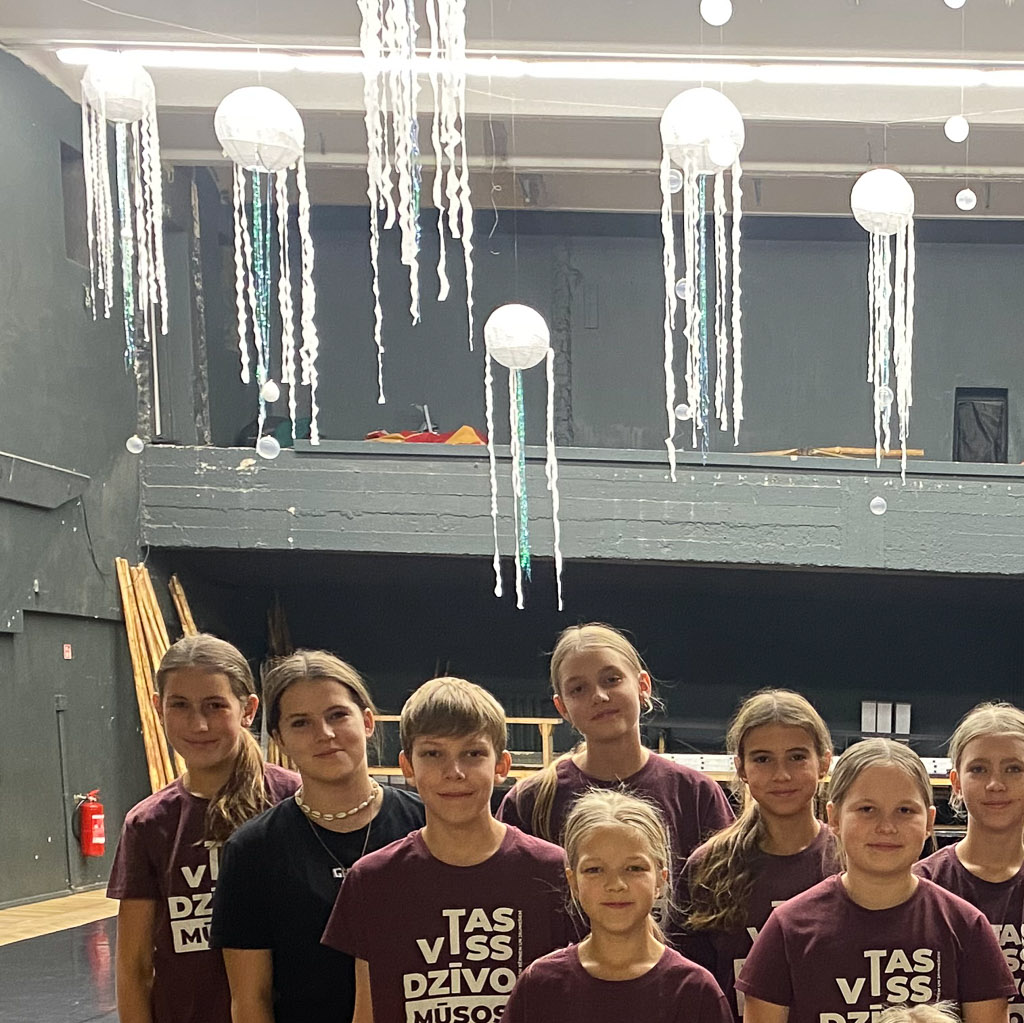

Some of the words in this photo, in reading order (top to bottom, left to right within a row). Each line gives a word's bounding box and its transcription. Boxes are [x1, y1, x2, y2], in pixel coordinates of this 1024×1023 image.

[442, 907, 515, 955] TAS
[403, 963, 517, 999] DZĪVO
[864, 949, 934, 997] TAS
